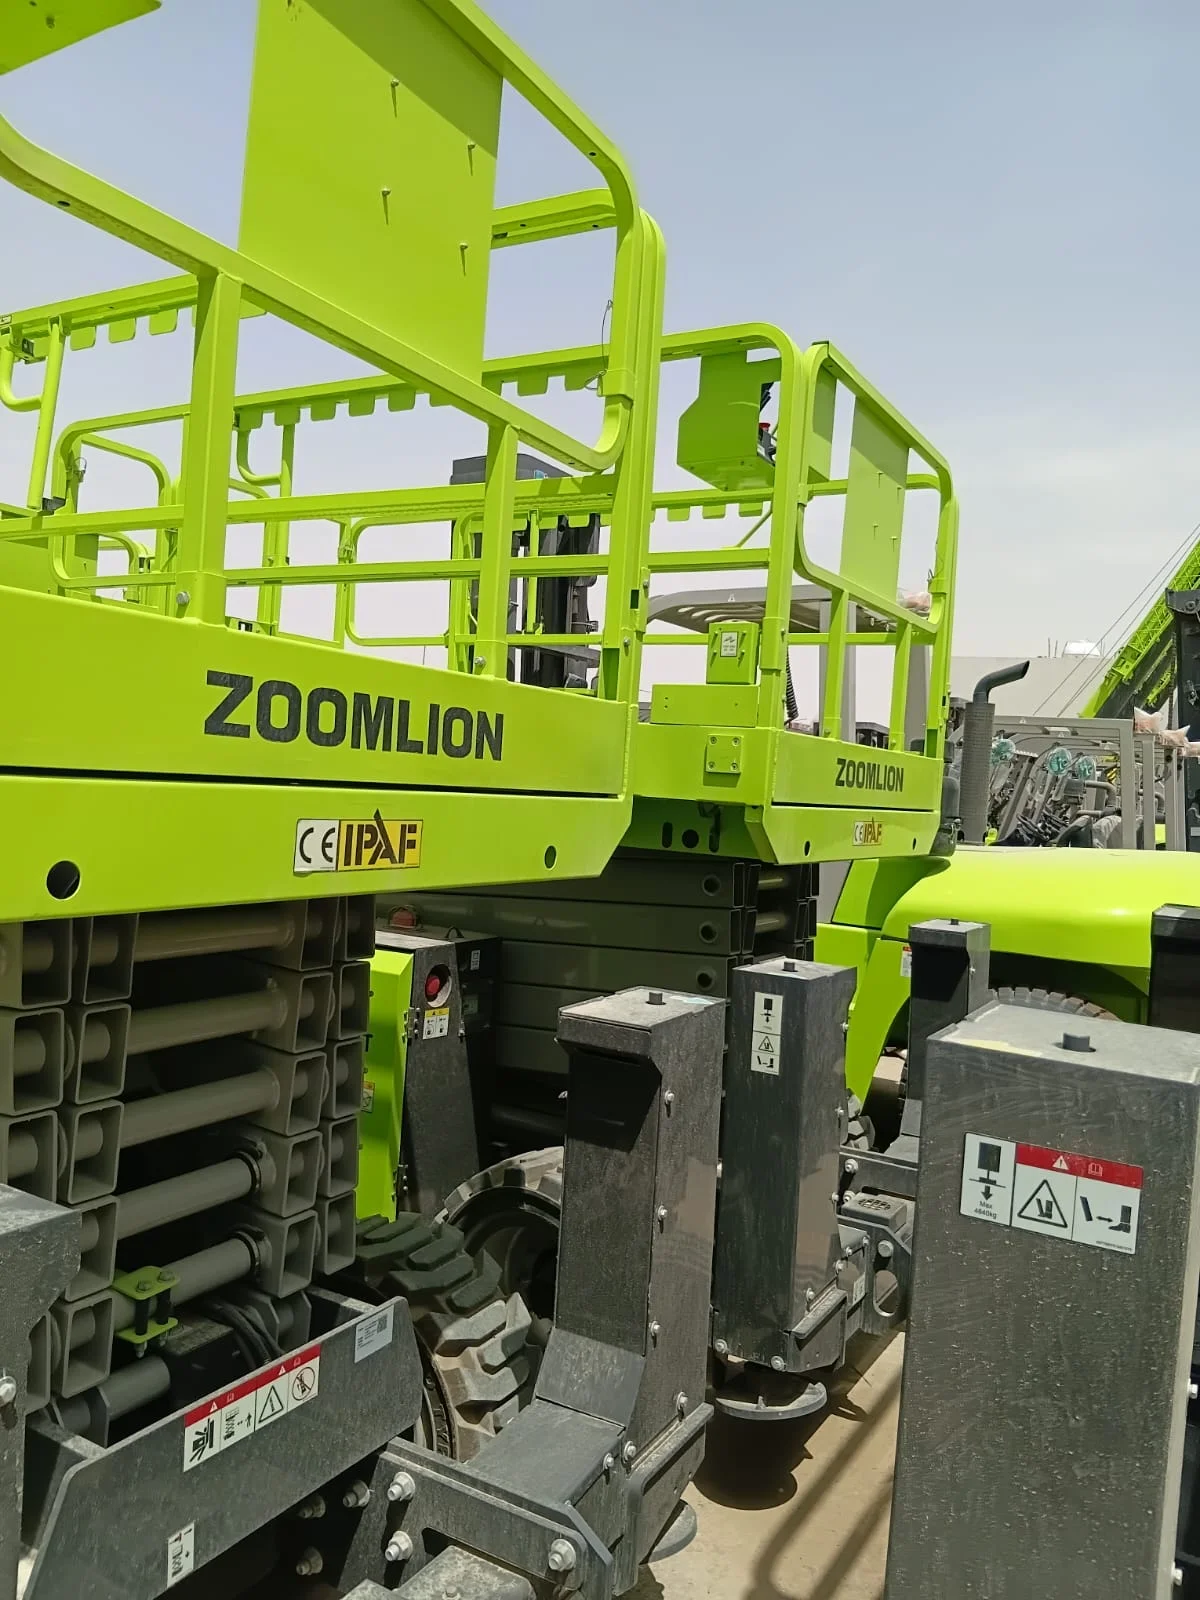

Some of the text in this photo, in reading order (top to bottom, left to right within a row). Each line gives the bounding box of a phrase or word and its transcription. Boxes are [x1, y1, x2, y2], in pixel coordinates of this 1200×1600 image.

[204, 670, 504, 761] ZOOMLION
[835, 758, 904, 792] ZOOMLION
[299, 807, 418, 867] CE IPAF
[864, 816, 882, 843] IPAF
